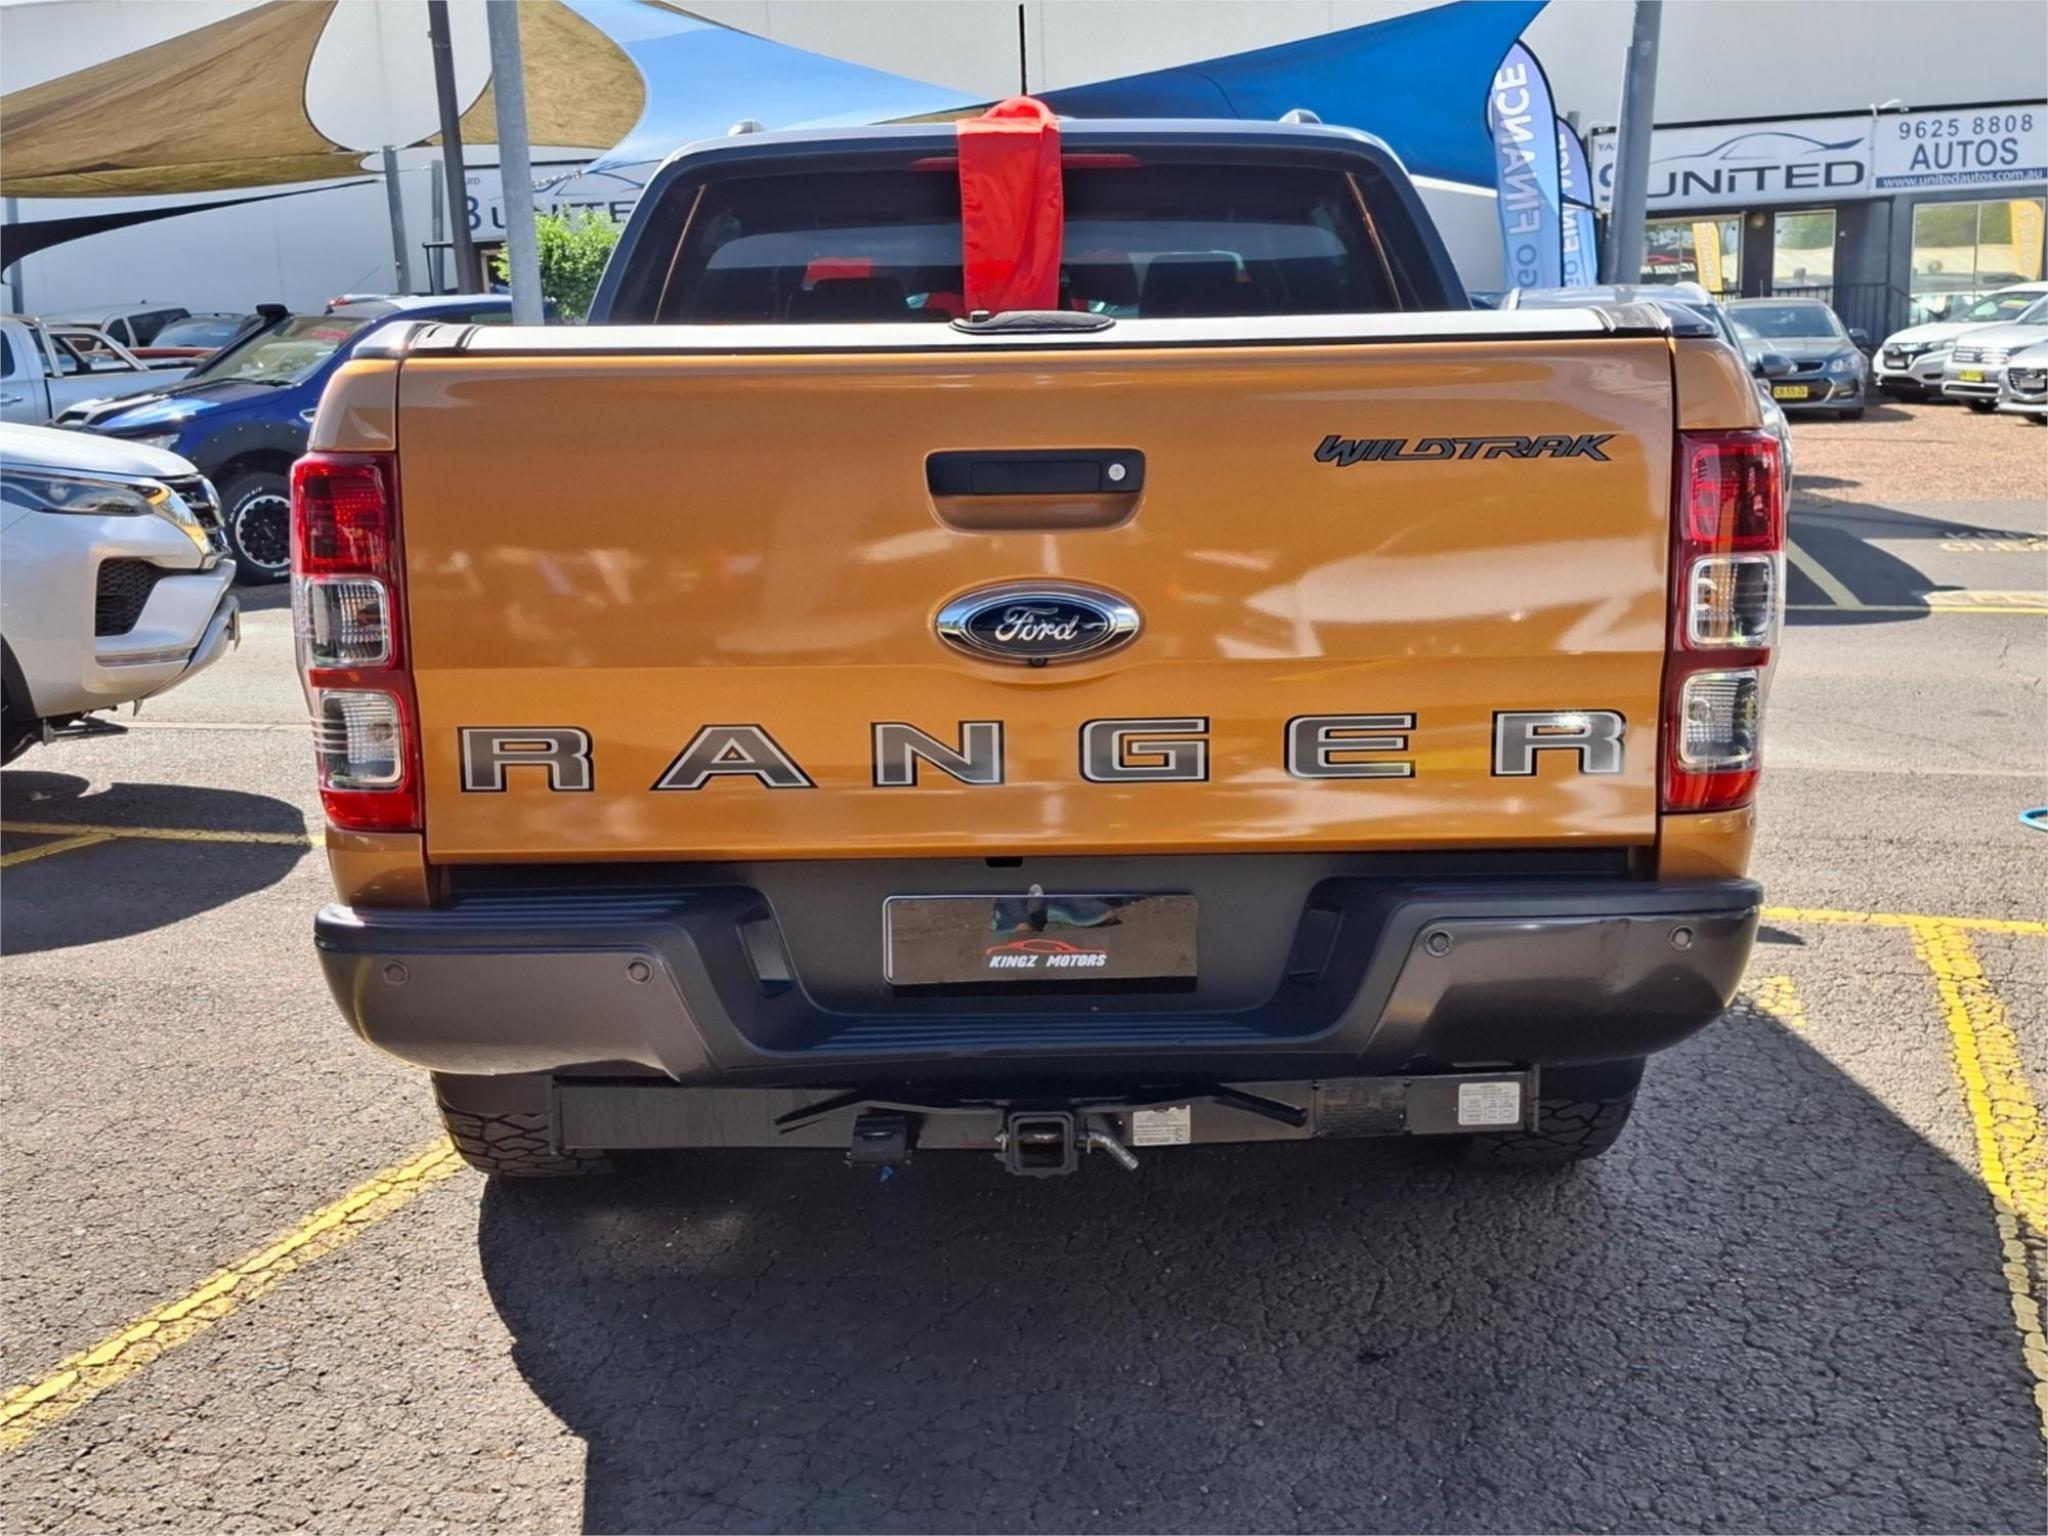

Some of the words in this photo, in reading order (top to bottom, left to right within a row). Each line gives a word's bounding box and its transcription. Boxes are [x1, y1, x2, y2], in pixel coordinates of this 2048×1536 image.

[1899, 118, 1960, 140] 9625
[1972, 113, 2034, 136] 8808
[1909, 137, 2019, 171] AUTOS
[1883, 168, 2043, 187] www.unitedautos.com.au
[1313, 433, 1618, 467] WILDTRAK
[994, 605, 1080, 642] Ford
[456, 708, 1627, 793] RANGER
[988, 955, 1039, 969] KINGZ
[1045, 954, 1108, 969] MOTORS
